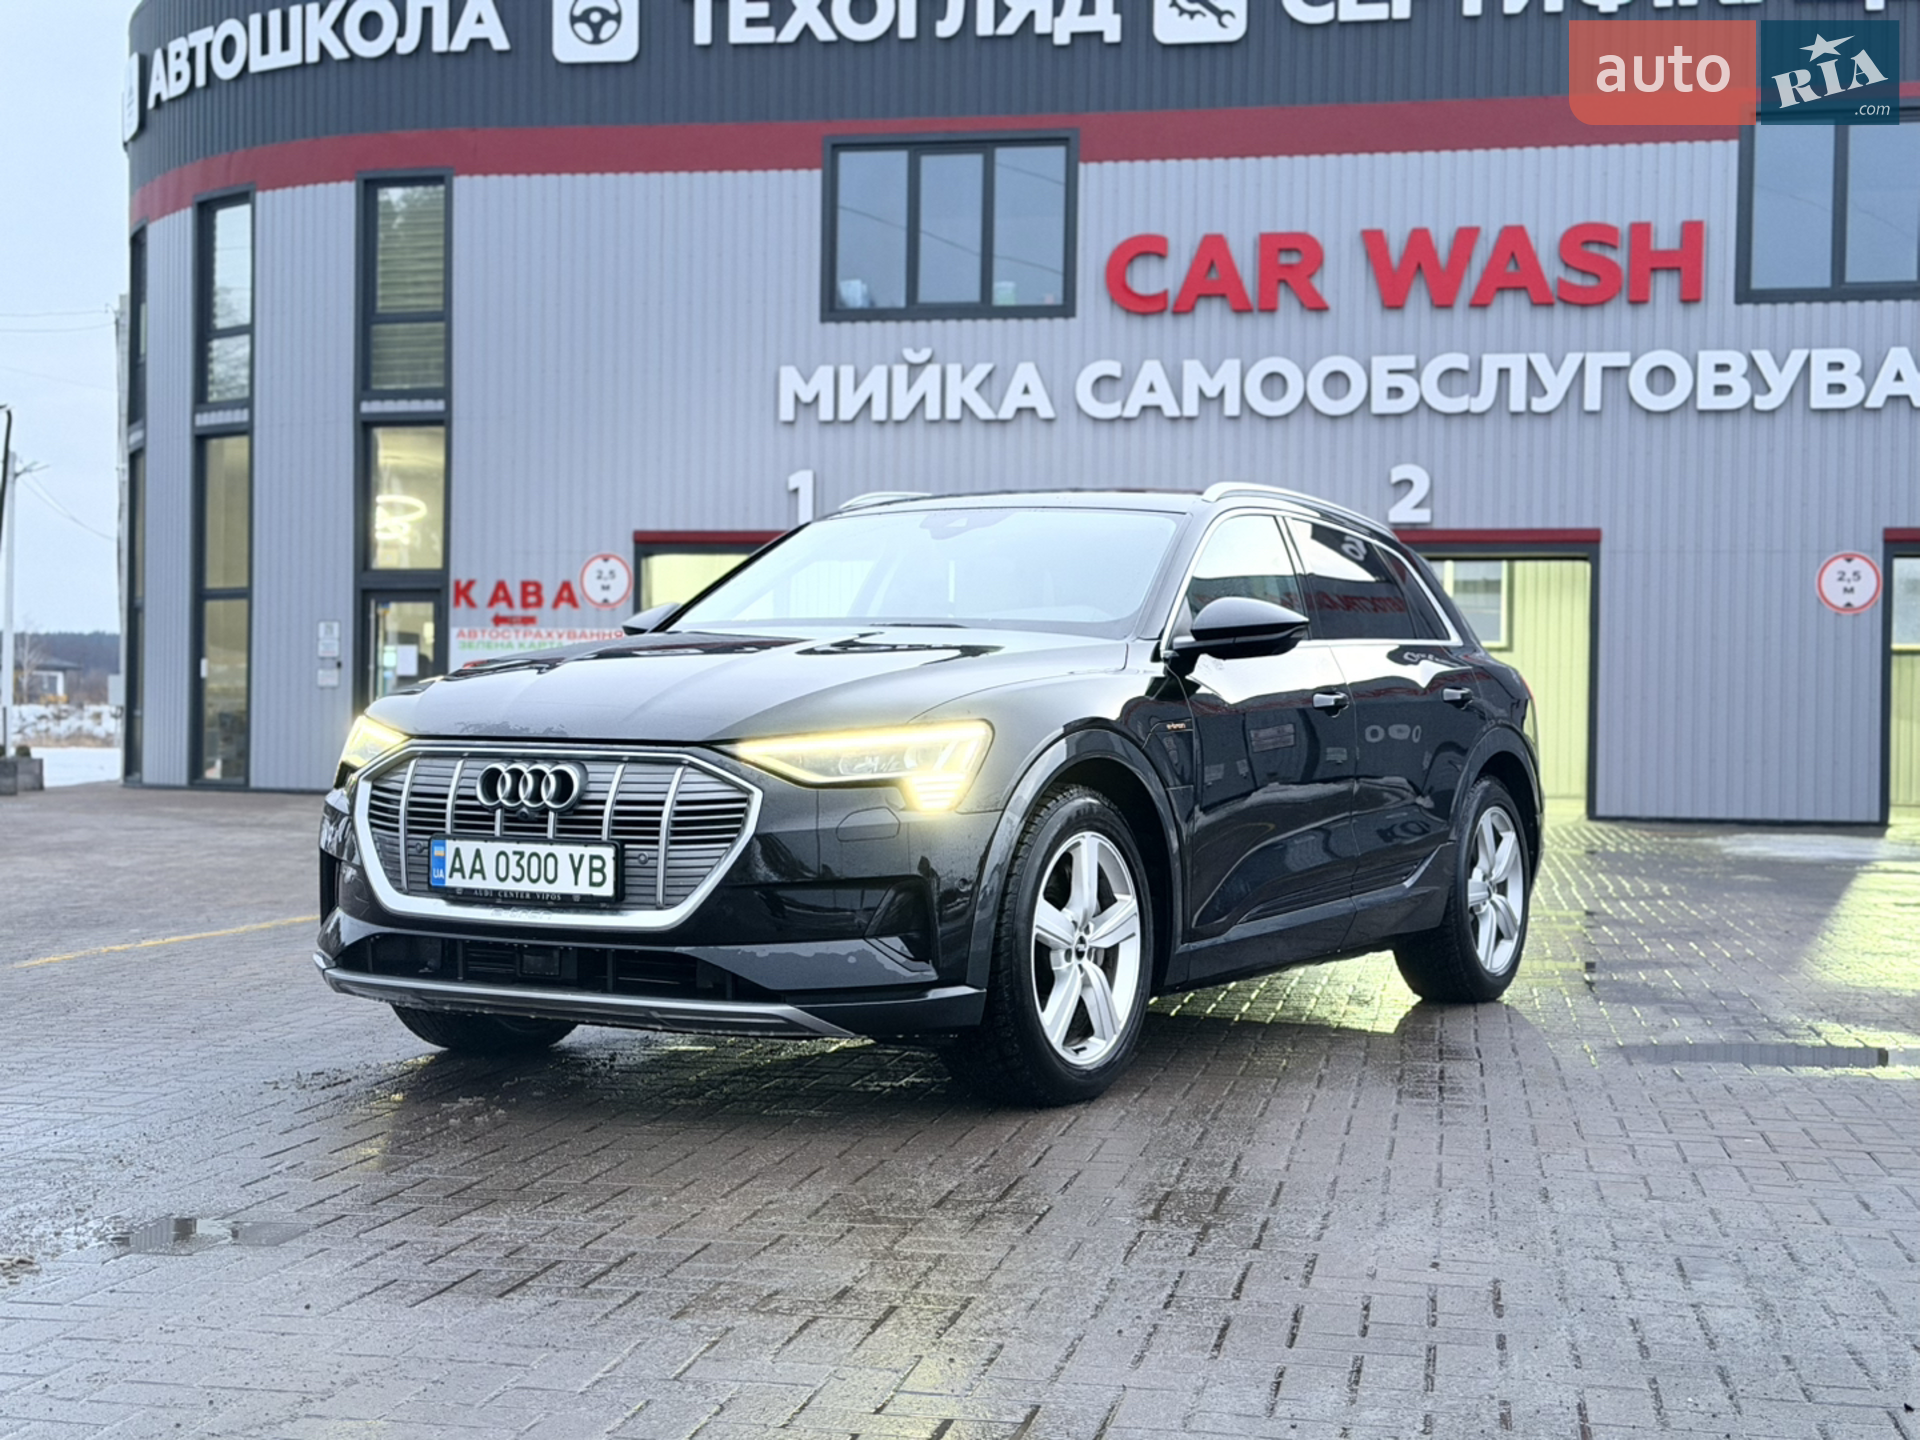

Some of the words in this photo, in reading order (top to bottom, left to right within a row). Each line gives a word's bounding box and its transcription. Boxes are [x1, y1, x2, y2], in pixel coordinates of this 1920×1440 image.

[147, 0, 510, 109] АВТОШКОЛА
[1105, 231, 1329, 314] CAR
[1360, 220, 1705, 308] WASH
[779, 347, 1056, 423] МИЙКА
[1075, 346, 1920, 419] САМООБСЛУГОВУВА
[788, 469, 815, 524] 1
[1387, 464, 1432, 524] 2
[453, 579, 580, 609] КАВА
[1837, 570, 1862, 583] 2,5
[456, 628, 624, 641] АВТОСТРАХУВАННЯ
[433, 868, 444, 879] UA
[449, 847, 486, 881] AA
[495, 850, 558, 884] 0300
[569, 853, 607, 887] YB
